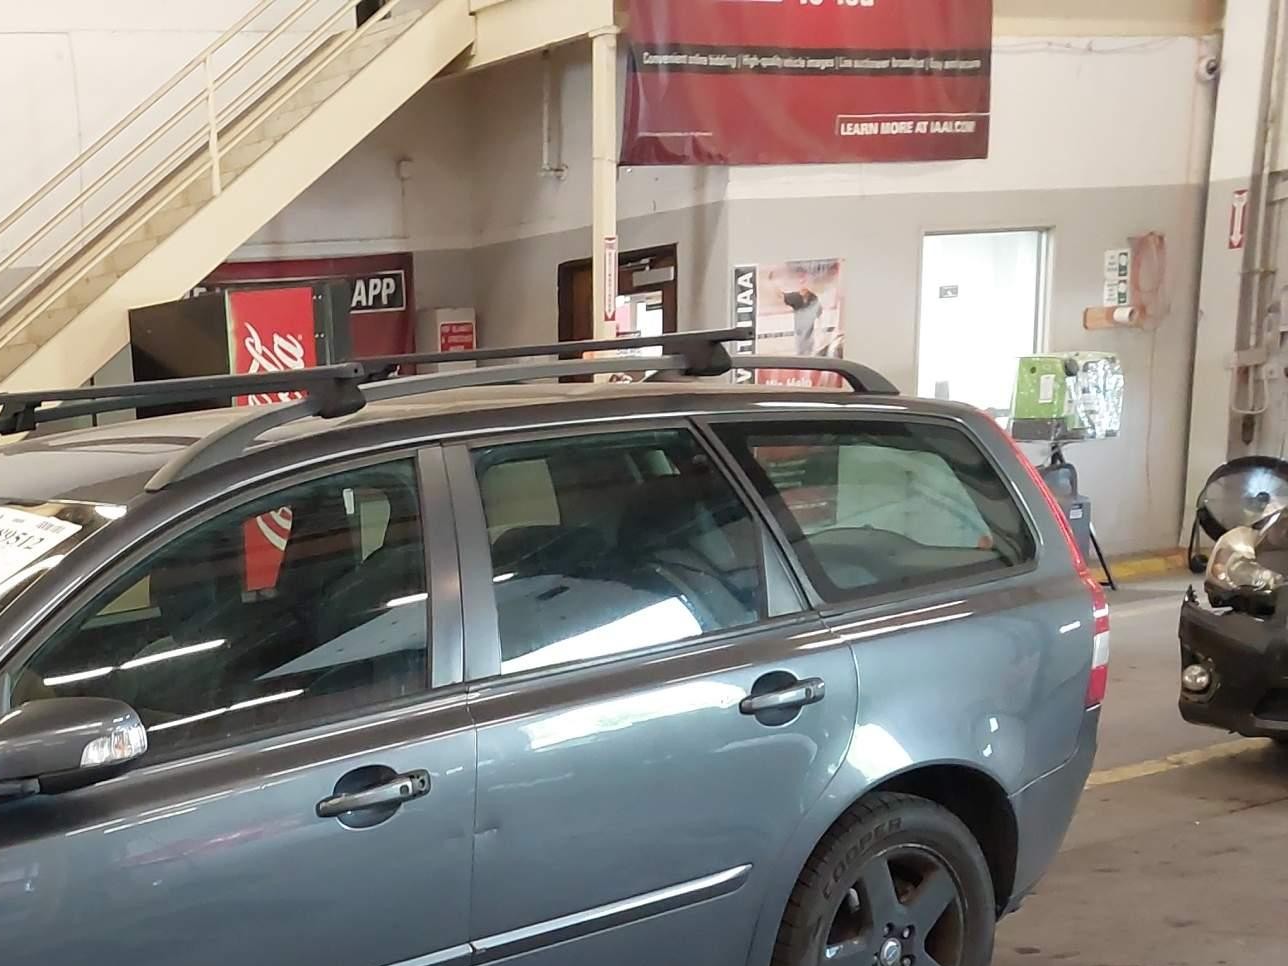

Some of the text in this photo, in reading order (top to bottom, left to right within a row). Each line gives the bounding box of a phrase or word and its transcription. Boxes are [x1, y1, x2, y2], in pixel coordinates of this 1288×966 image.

[840, 123, 878, 135] LEARN
[880, 121, 914, 134] MORE
[914, 121, 928, 133] AT
[351, 278, 396, 307] APP
[823, 817, 903, 899] COOPER
